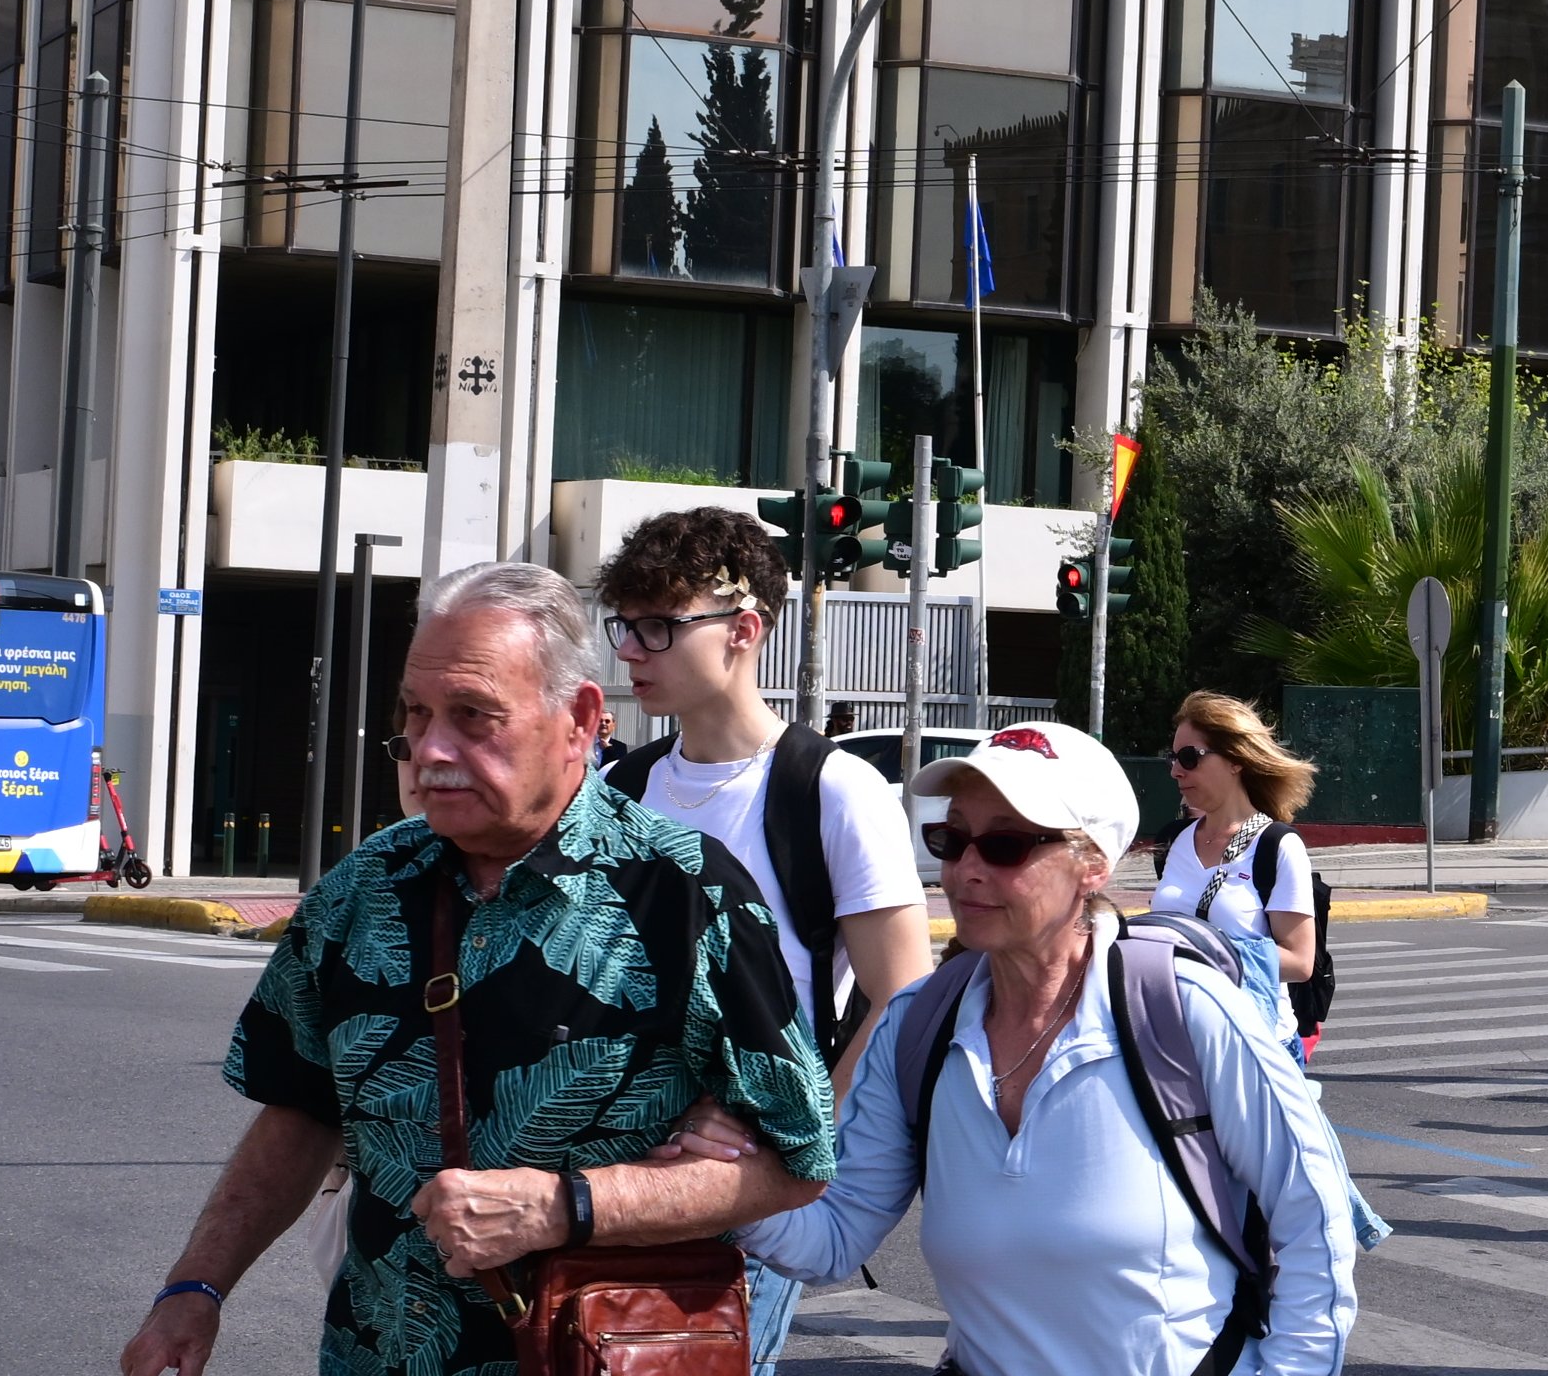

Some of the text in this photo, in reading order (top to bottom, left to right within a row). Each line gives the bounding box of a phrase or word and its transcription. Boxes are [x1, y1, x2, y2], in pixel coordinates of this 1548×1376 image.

[62, 613, 86, 624] 4476
[4, 646, 51, 661] φρέσκα
[54, 650, 76, 662] μας
[23, 663, 67, 679] μεγάλη
[29, 767, 59, 782] ξέρει
[1, 781, 44, 798] ξέρει.
